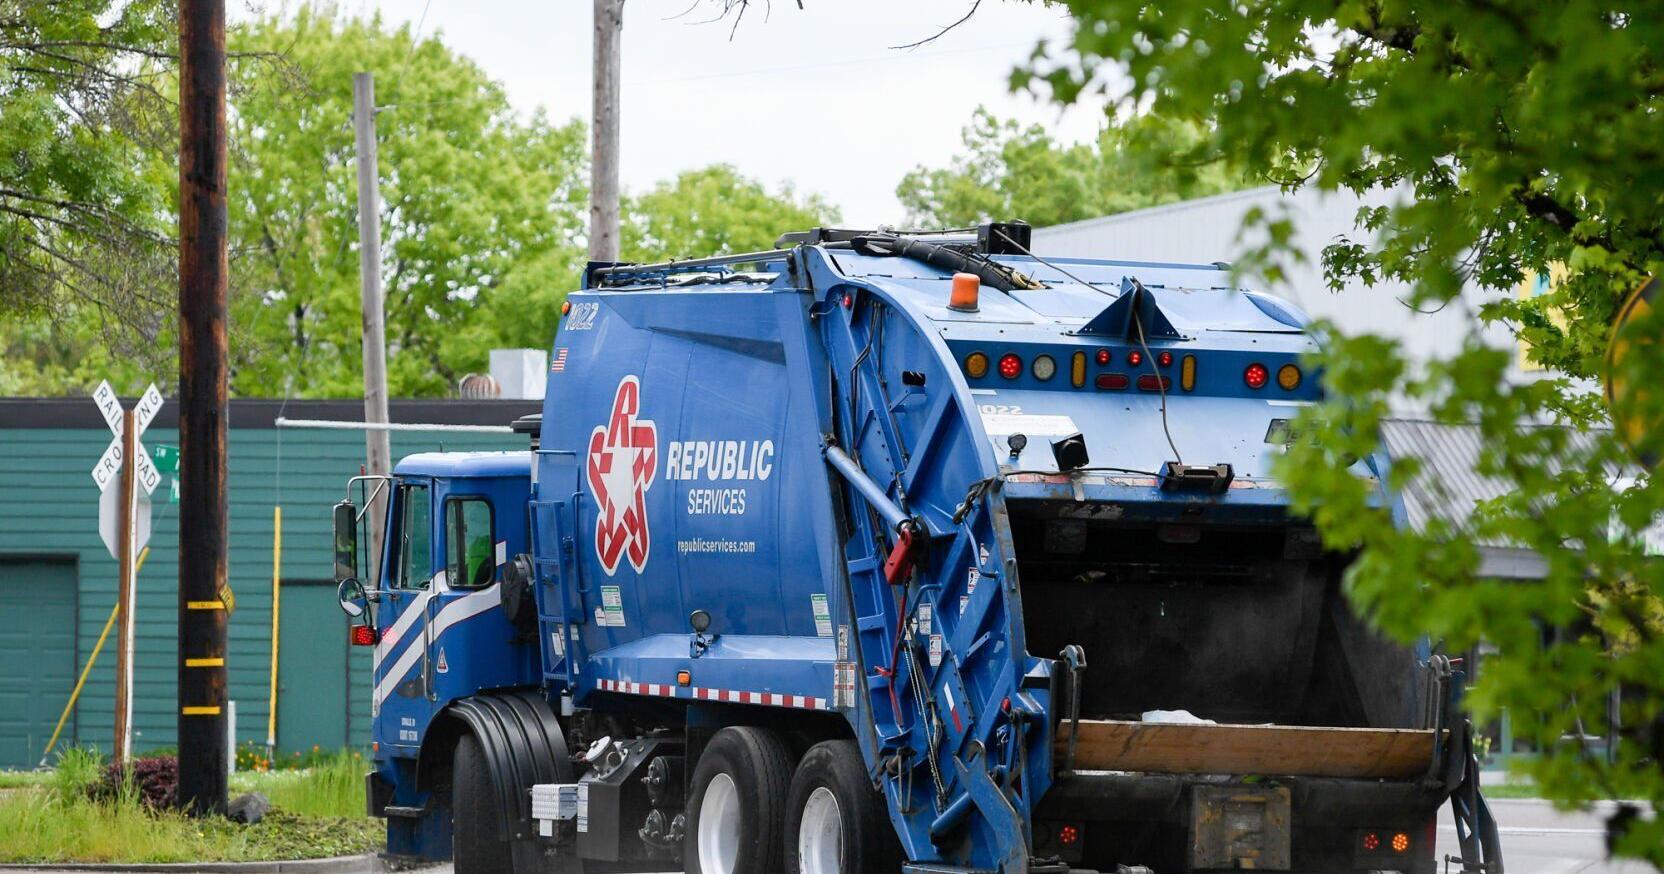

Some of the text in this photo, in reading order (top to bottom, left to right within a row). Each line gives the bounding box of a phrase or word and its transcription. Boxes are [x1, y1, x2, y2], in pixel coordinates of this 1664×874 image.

[156, 447, 167, 458] SW
[665, 439, 774, 481] REPUBLIC
[687, 488, 746, 515] SERVICES
[677, 538, 755, 556] republicservices.com
